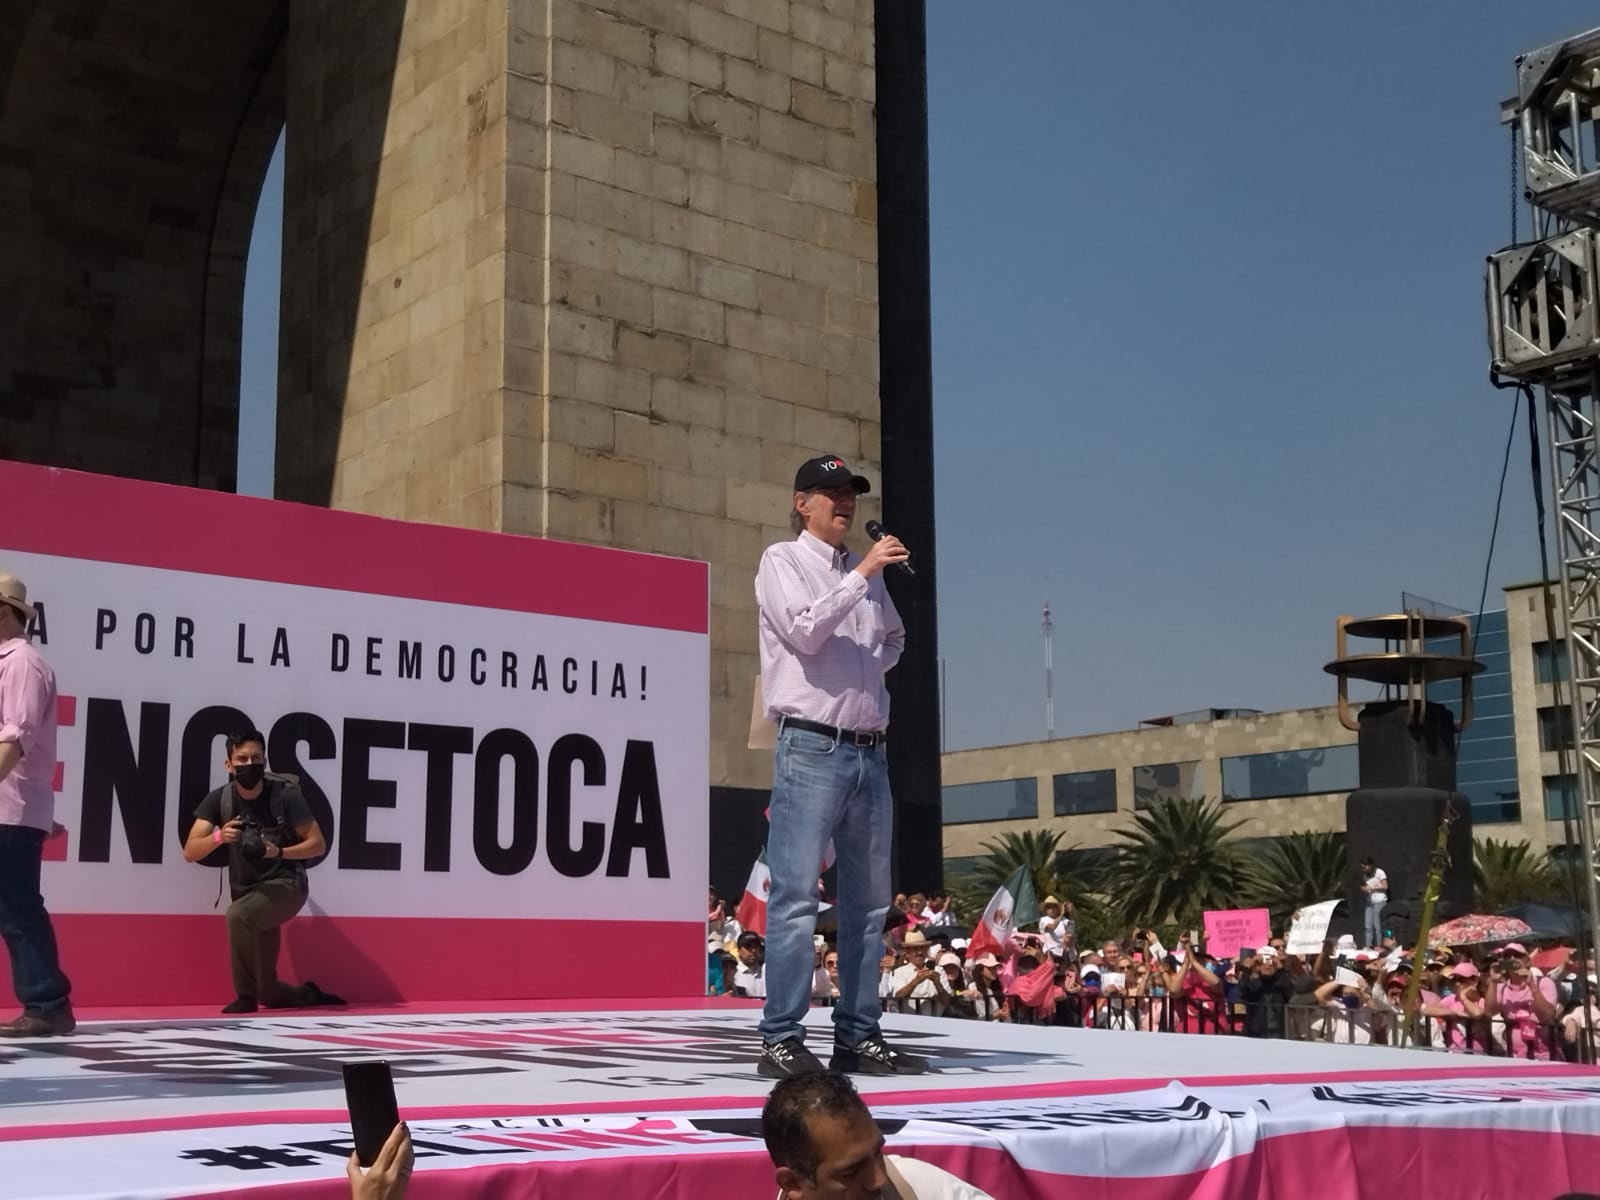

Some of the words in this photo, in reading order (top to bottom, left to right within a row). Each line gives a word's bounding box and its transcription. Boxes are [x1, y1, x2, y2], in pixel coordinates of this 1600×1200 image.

[96, 608, 195, 659] POR
[237, 622, 291, 668] LA
[330, 633, 649, 701] DEMOCRACIA!
